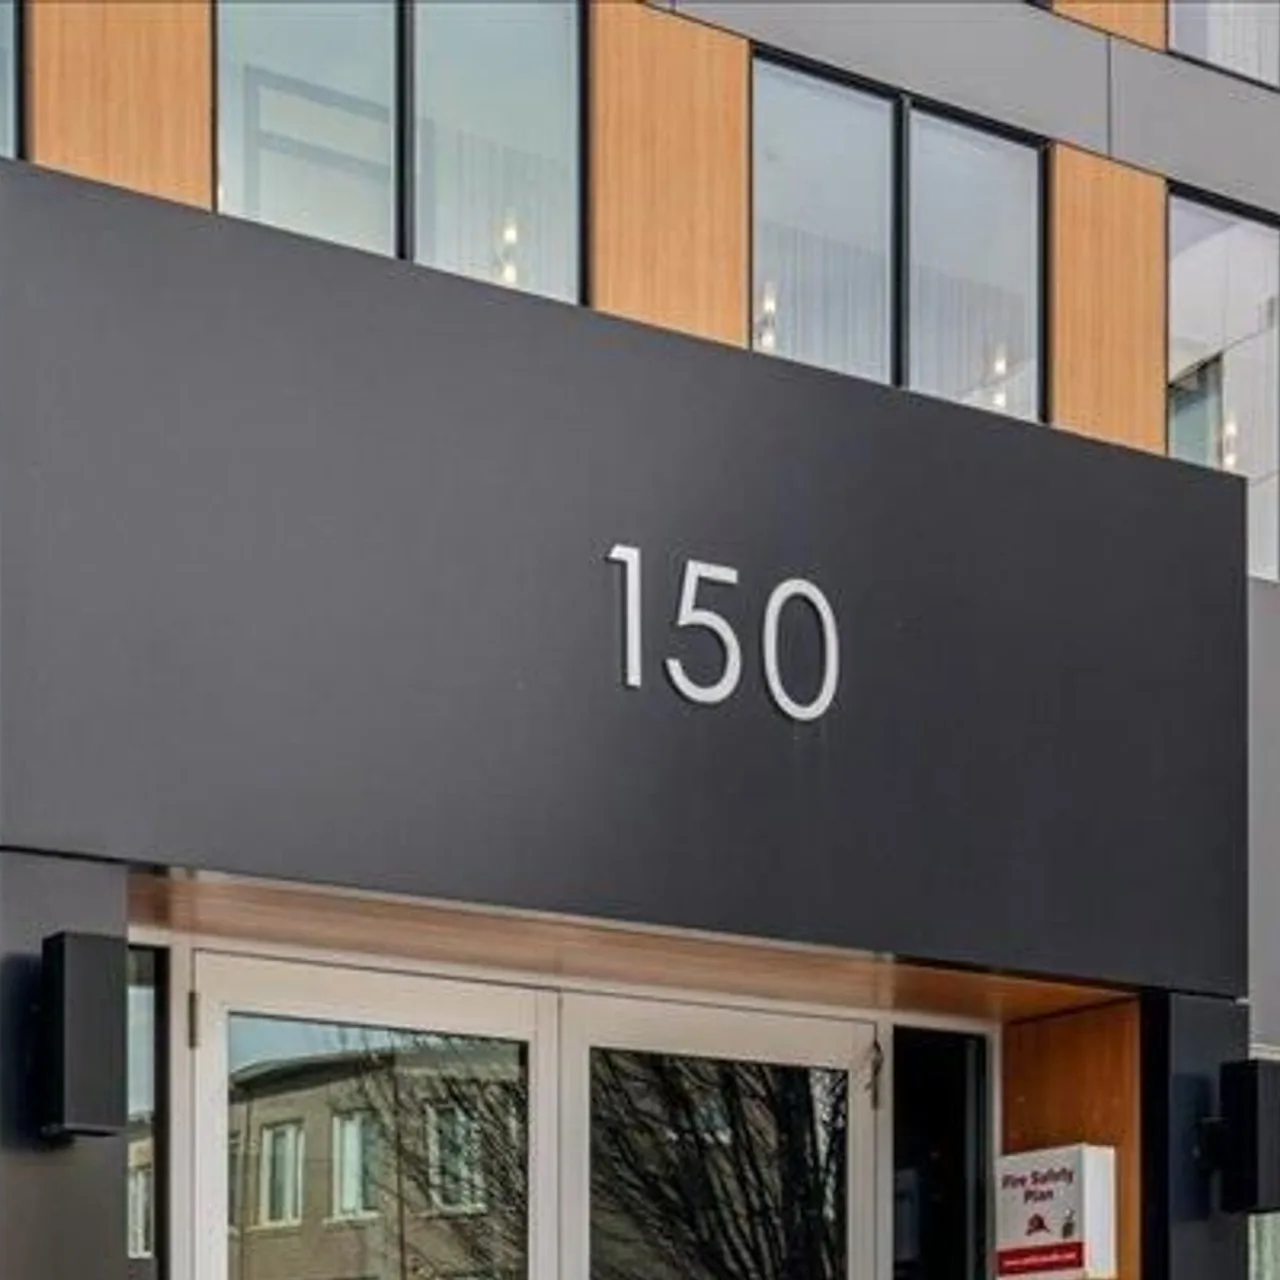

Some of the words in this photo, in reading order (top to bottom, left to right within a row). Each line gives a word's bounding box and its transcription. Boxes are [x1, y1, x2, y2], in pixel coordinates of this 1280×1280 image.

[608, 543, 839, 722] 150
[1002, 1174, 1028, 1189] Fire
[1030, 1167, 1074, 1185] Safety
[1023, 1189, 1054, 1204] Plan
